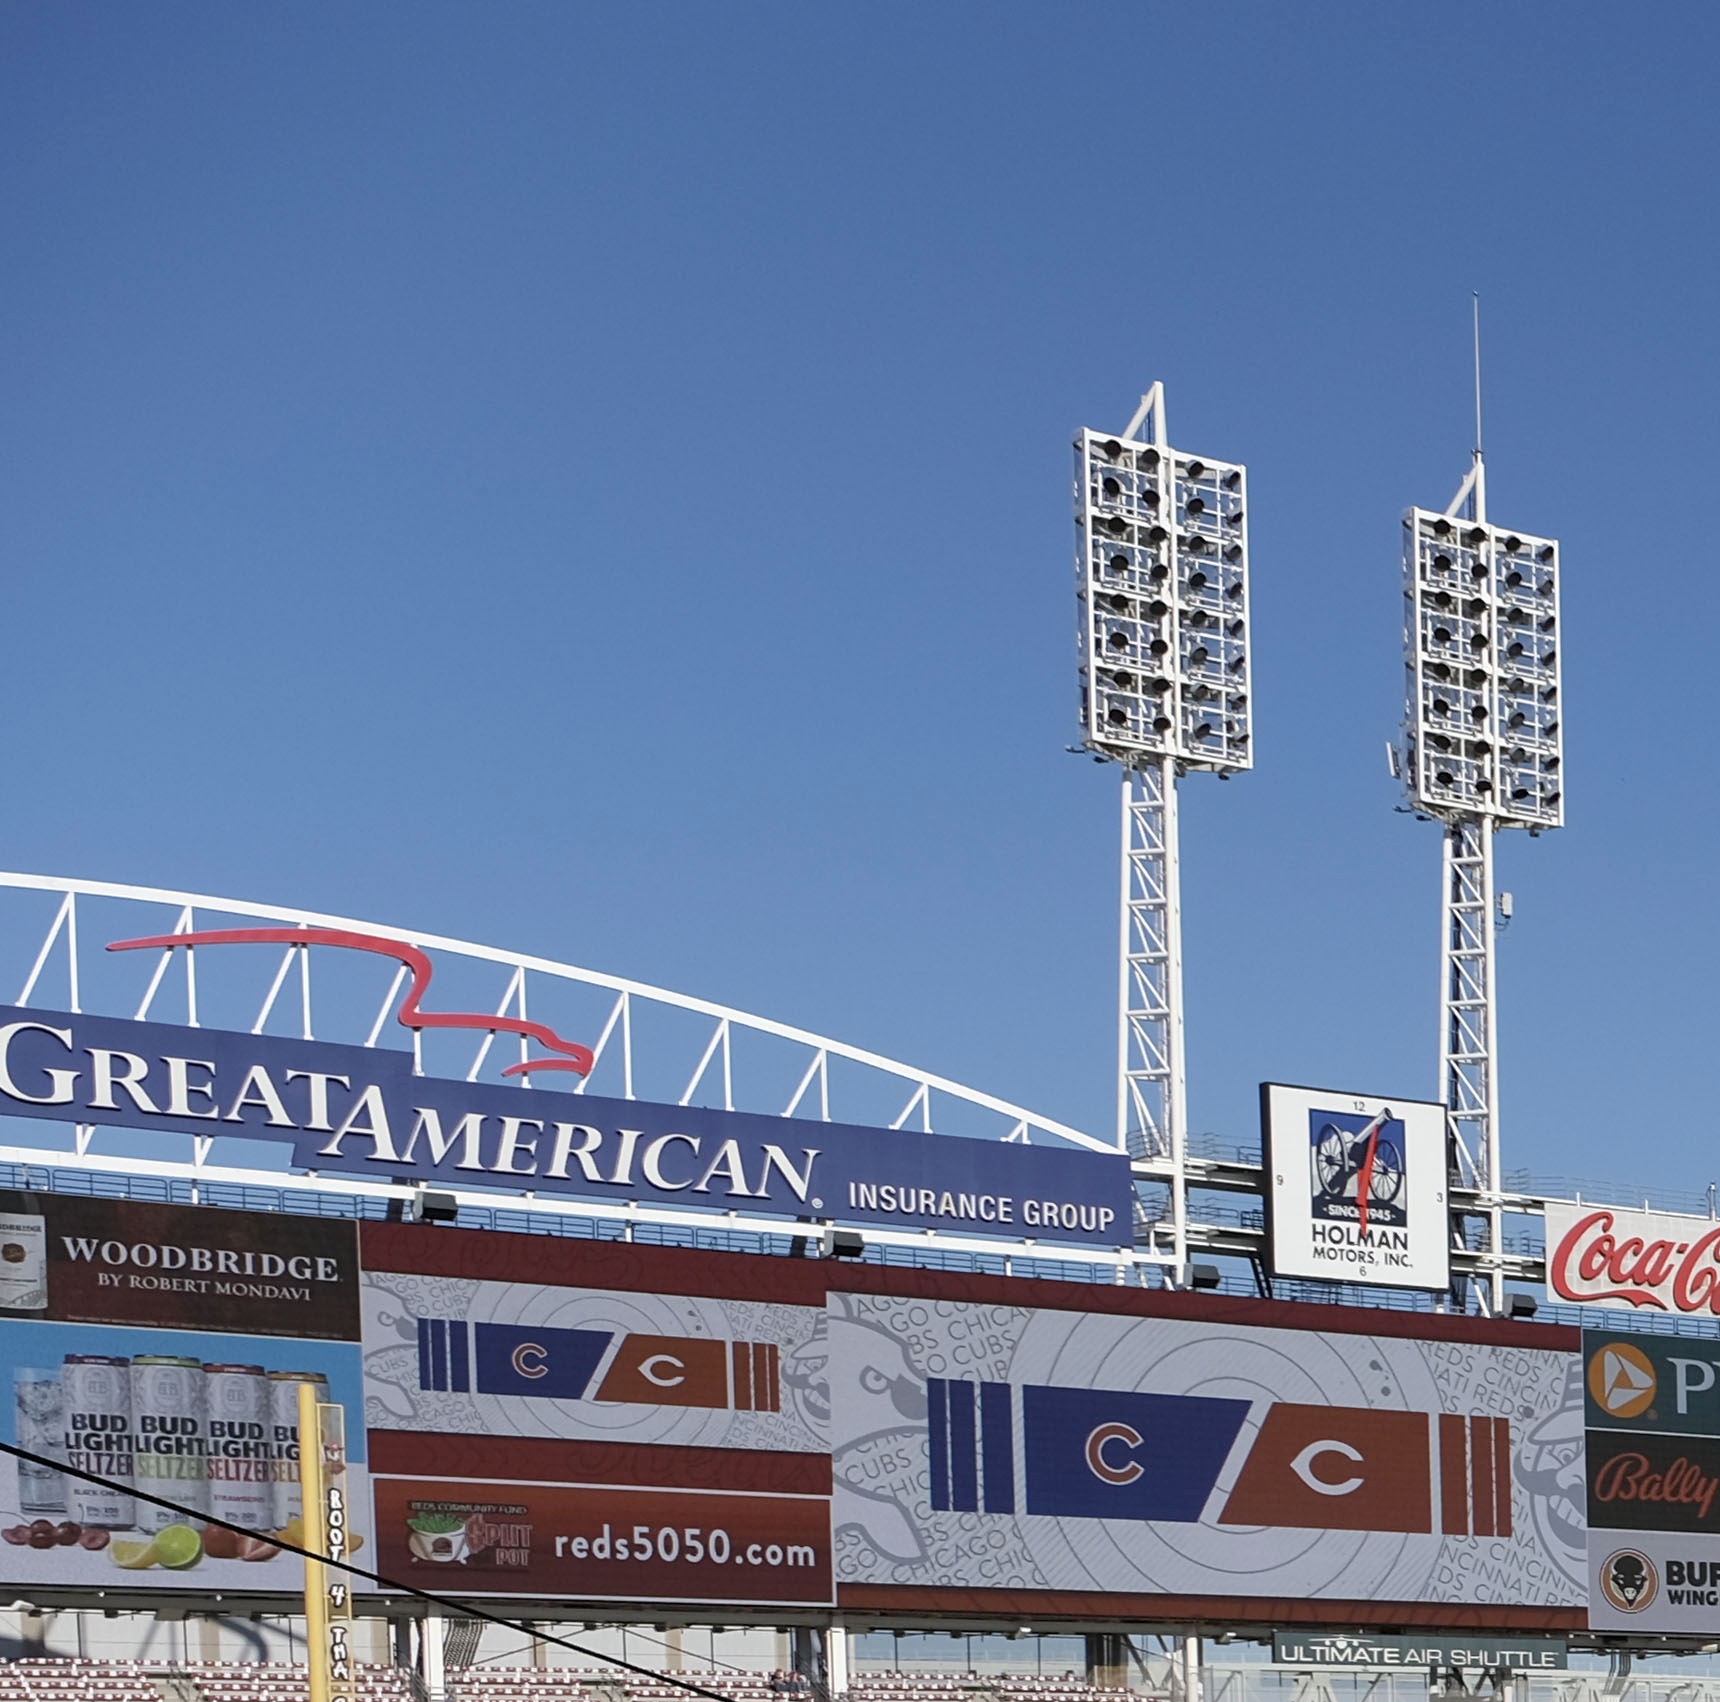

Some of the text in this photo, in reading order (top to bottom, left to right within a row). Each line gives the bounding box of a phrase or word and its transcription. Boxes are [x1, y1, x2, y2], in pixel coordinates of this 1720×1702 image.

[0, 1021, 818, 1202] GREAT AMERICAN
[1353, 1101, 1366, 1112] 12
[849, 1181, 1116, 1233] INSURANCE GROUP
[1312, 1223, 1408, 1251] HOLMAN
[61, 1236, 339, 1282] WOODBRIDGE
[1313, 1246, 1413, 1267] MOTORS, INC.
[98, 1273, 312, 1301] BY ROBERT MONDAVI
[72, 1413, 128, 1432] BUD
[141, 1415, 198, 1436] BUD
[210, 1420, 264, 1440] BUD
[207, 1458, 269, 1483] SELTZER
[1594, 1451, 1718, 1518] Bally
[554, 1524, 816, 1567] reds5050.com
[1281, 1645, 1559, 1667] ULTIMATE AIR SHUTTLE
